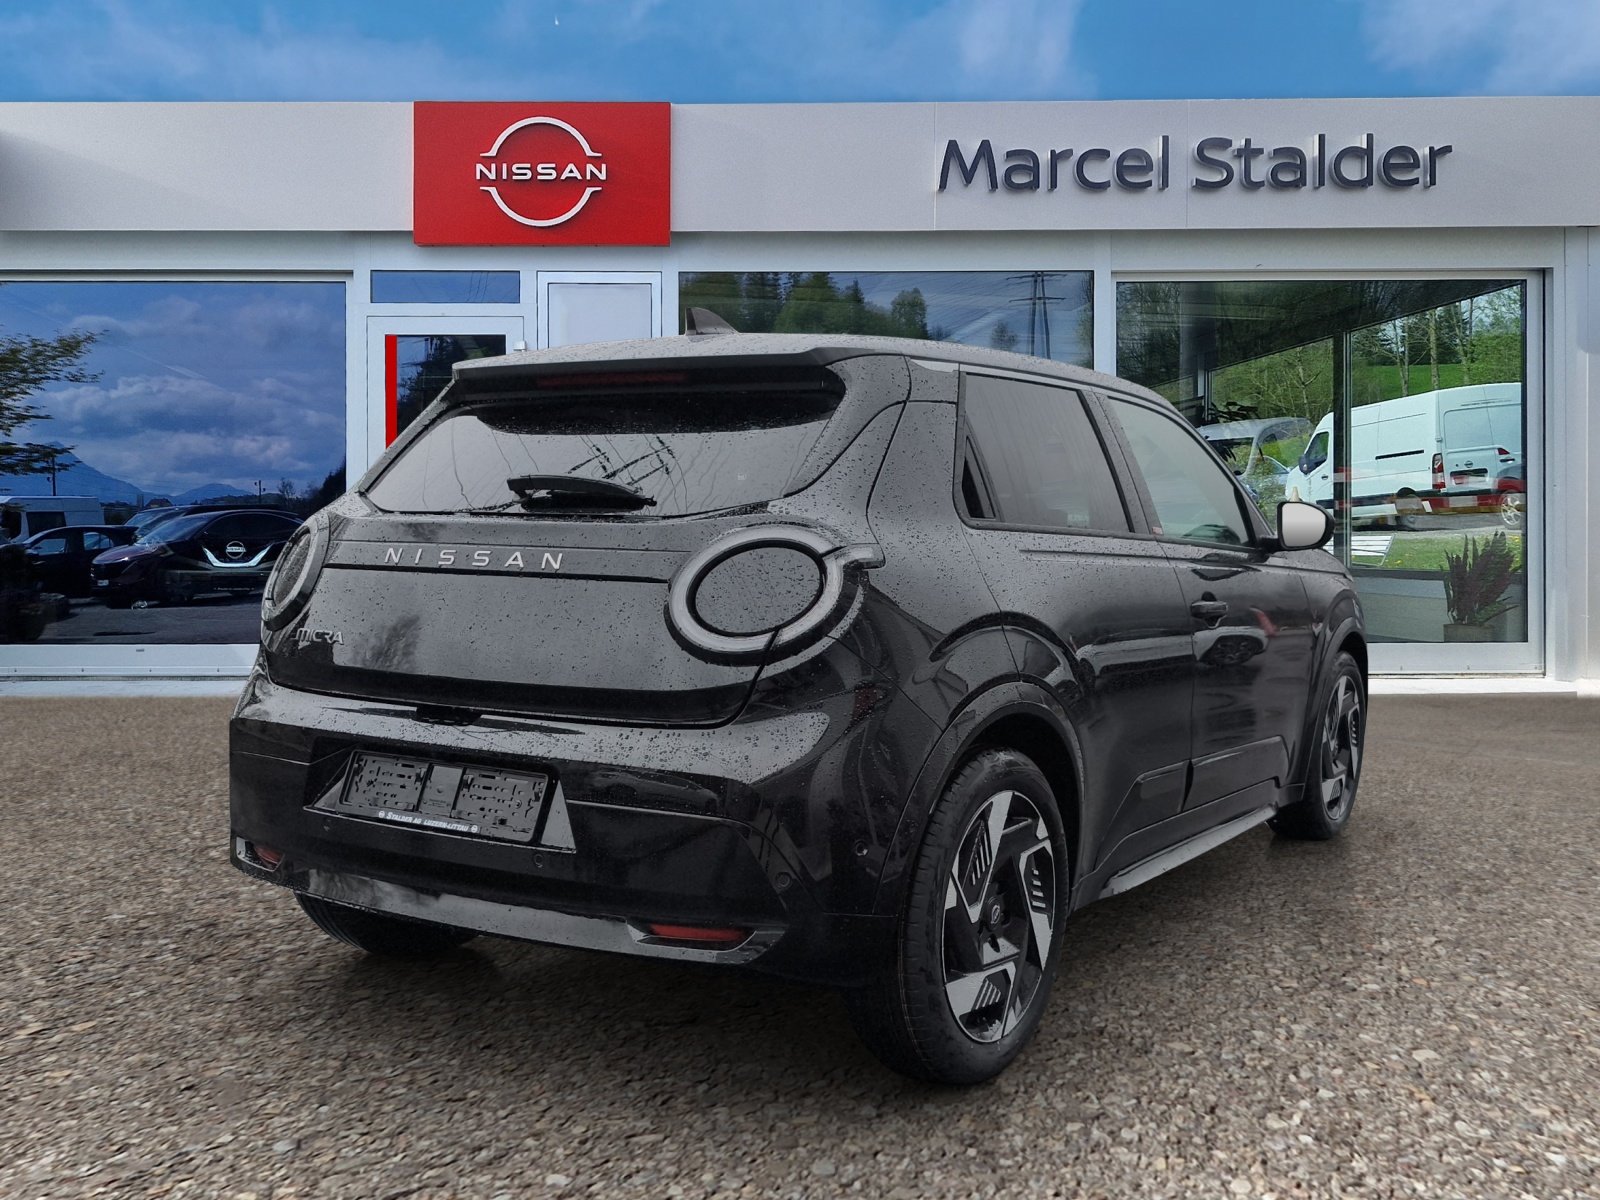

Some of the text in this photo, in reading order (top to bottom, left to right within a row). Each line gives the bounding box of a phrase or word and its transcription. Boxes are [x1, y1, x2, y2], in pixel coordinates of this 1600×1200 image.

[475, 163, 607, 181] NISSAN
[937, 132, 1453, 192] Marcel Stalder
[384, 547, 564, 570] NISSAN
[291, 627, 344, 645] MICRA
